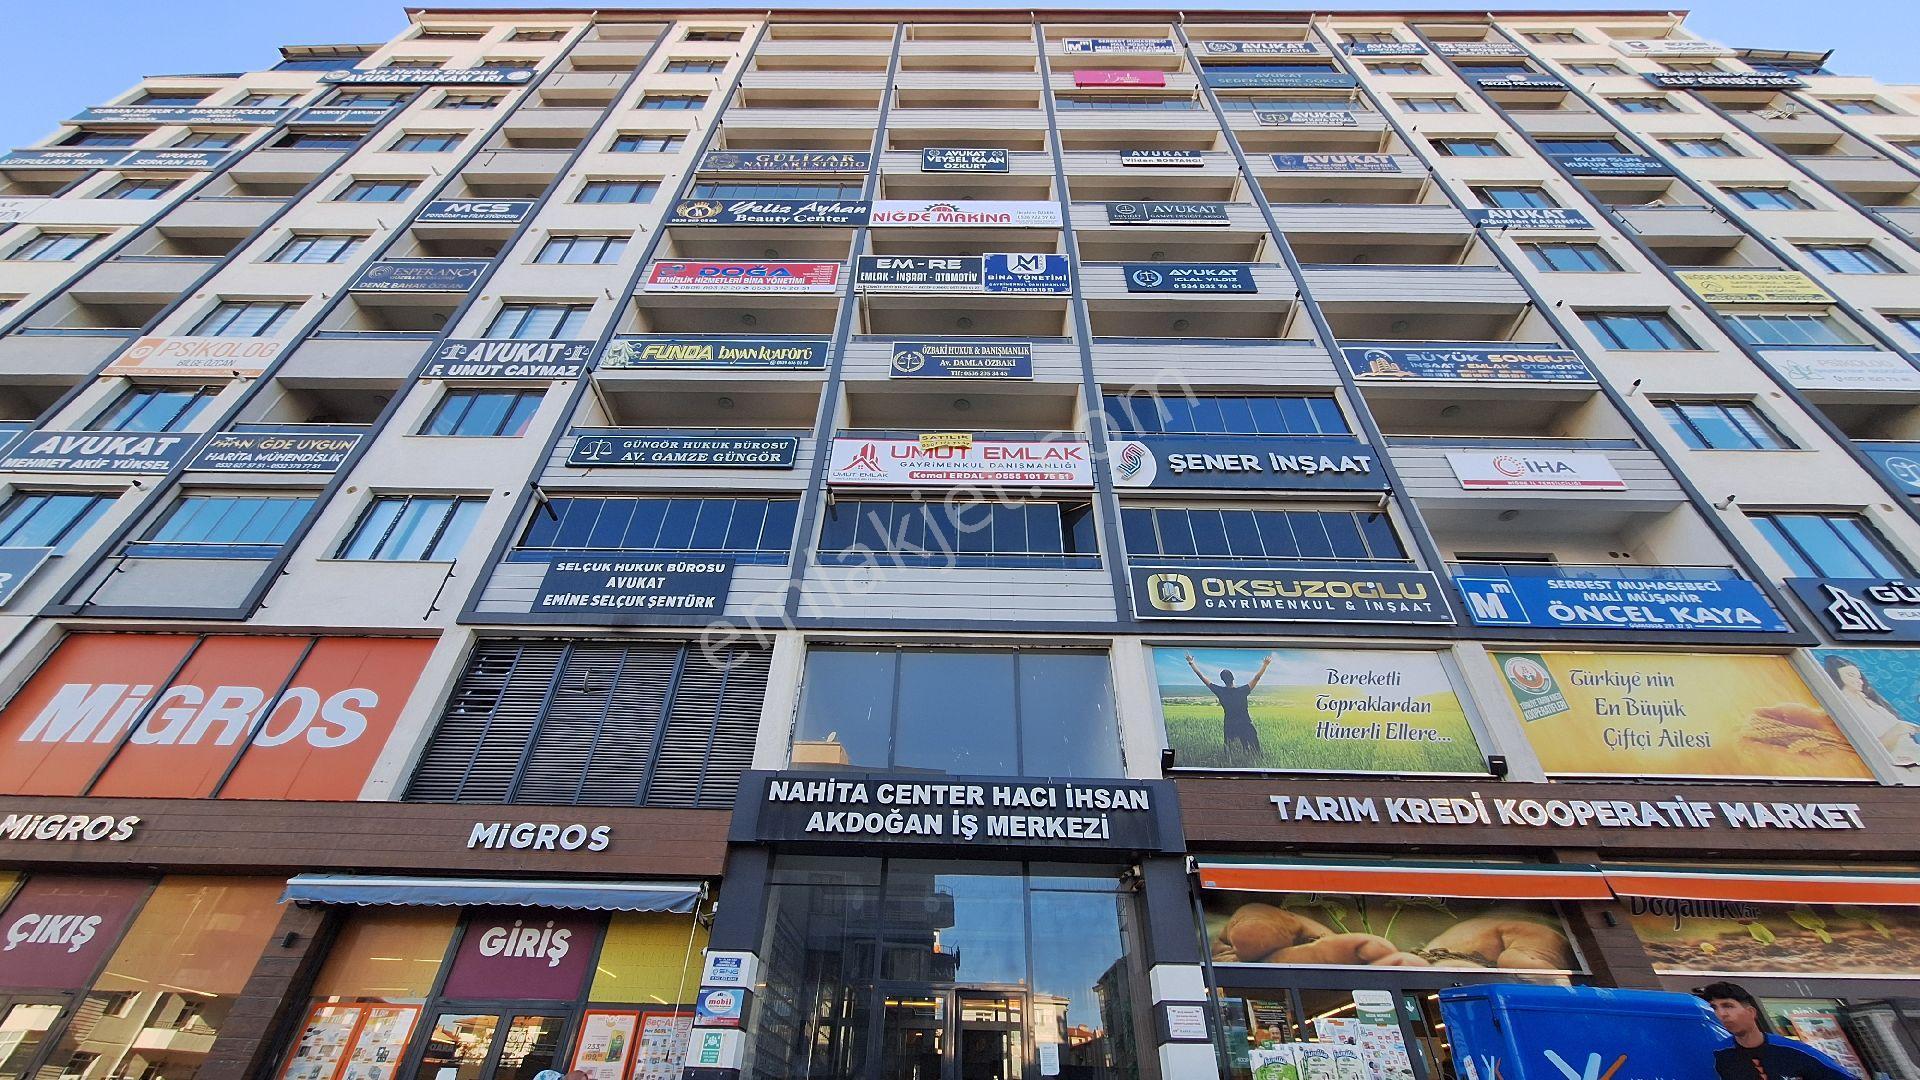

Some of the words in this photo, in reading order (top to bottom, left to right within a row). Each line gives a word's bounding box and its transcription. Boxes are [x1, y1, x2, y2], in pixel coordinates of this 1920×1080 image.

[757, 154, 856, 162] GÜLİZAR
[1303, 155, 1389, 163] AVUKAT
[444, 203, 512, 213] MCS
[728, 201, 793, 215] Yeliz
[793, 201, 867, 216] Ayhan
[1488, 209, 1567, 219] AVUKAT
[734, 214, 790, 224] Beauty
[794, 214, 849, 222] Center
[872, 210, 930, 222] NİĞDE
[936, 212, 1010, 222] MAKİNA
[699, 264, 792, 278] DOĞA
[860, 272, 894, 281] EMLAK
[896, 271, 928, 284] İNŞAAT
[935, 272, 978, 282] OTOMOTİV
[656, 276, 697, 284] TEMİZLİK
[697, 276, 743, 284] HİZMETLERİ
[744, 276, 764, 284] BİNA
[765, 276, 805, 285] YÖNETİMİ
[464, 342, 566, 362] AVUKAT
[639, 344, 714, 361] FUNDA
[948, 346, 974, 355] HUKUK
[981, 346, 1030, 357] DANIŞMANLIK
[447, 364, 504, 376] UMUT
[939, 359, 951, 367] Av.
[29, 436, 182, 455] AVUKAT
[297, 439, 356, 450] UYGUN
[623, 439, 681, 449] GÜNGÖR
[683, 441, 730, 449] HUKUK
[732, 440, 789, 449] BÜROSU
[204, 450, 253, 461] HARİTA
[255, 451, 344, 462] MÜHENDİSLİK
[620, 452, 645, 461] AV.
[651, 453, 708, 462] GAMZE
[712, 451, 782, 462] GÜNGÖR
[984, 446, 1086, 460] EMLAK
[0, 458, 72, 468] MEHMET
[69, 457, 110, 469] AKİF
[112, 457, 171, 469] YÜKSEL
[1168, 453, 1264, 474] ŞENER
[1268, 452, 1371, 474] İNŞAAT
[1523, 457, 1577, 473] İHA
[911, 471, 947, 479] Kemal
[556, 562, 612, 573] SELÇUK
[614, 563, 664, 572] HUKUK
[667, 561, 725, 573] BÜROSU
[605, 577, 666, 589] AVUKAT
[1547, 579, 1613, 591] SERBEST
[1618, 581, 1722, 592] MUHASEBECİ
[542, 592, 590, 606] EMİNE
[590, 595, 645, 609] SELÇUK
[648, 594, 717, 609] ŞENTÜRK
[1583, 591, 1623, 602] MALİ
[1628, 591, 1703, 605] MÜŞAVİR
[1204, 598, 1336, 611] GAYRİMENKUL
[1345, 600, 1356, 610] &
[1365, 599, 1433, 613] İNŞAAT
[1547, 600, 1668, 625] ÖNCEL
[1670, 607, 1763, 625] KAYA
[1325, 668, 1401, 687] Bereketli
[1315, 694, 1431, 719] Topraklardan
[1594, 697, 1621, 716] En
[1621, 697, 1687, 724] Büyük
[1316, 721, 1381, 741] Hünerli
[1603, 728, 1652, 751] Çiftçi
[1658, 729, 1711, 748] Ailesi
[768, 777, 869, 804] NAHİTA
[877, 783, 984, 807] CENTER
[993, 786, 1056, 808] HACI
[1066, 781, 1150, 811] İHSAN
[1270, 794, 1380, 823] TARIM
[1385, 790, 1492, 825] KREDİ
[1494, 795, 1716, 829] KOOPERATİF
[1717, 802, 1867, 830] MARKET
[805, 808, 943, 835] AKDOĞAN
[953, 810, 979, 842] İŞ
[986, 813, 1109, 840] MERKEZİ
[3, 913, 103, 953] ÇIKIŞ
[479, 919, 573, 967] GİRİŞ
